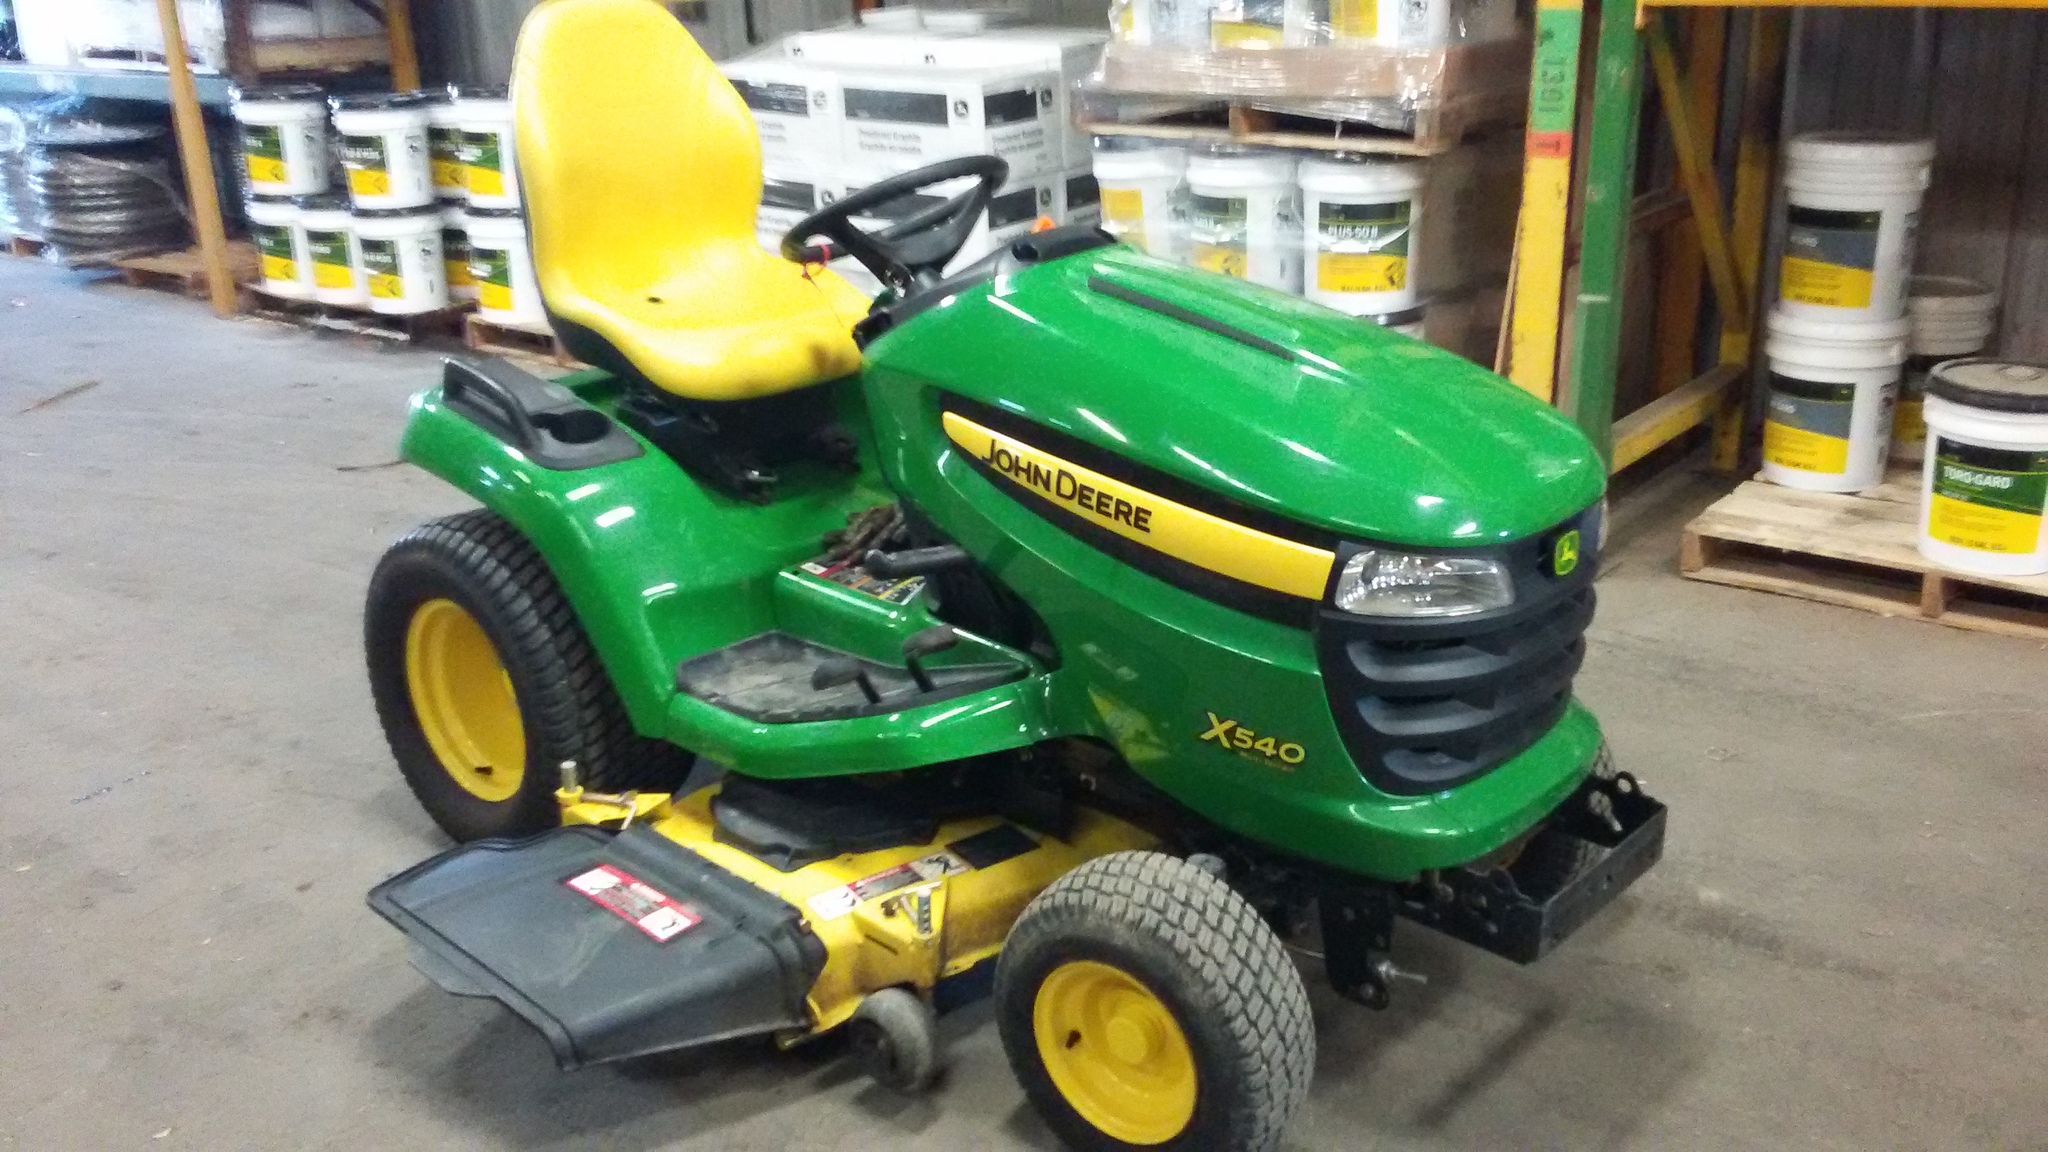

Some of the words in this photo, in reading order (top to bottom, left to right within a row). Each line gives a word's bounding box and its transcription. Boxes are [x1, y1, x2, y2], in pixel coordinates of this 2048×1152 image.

[980, 438, 1052, 492] JOHN
[1055, 468, 1153, 533] DEERE
[1199, 710, 1307, 764] X540
